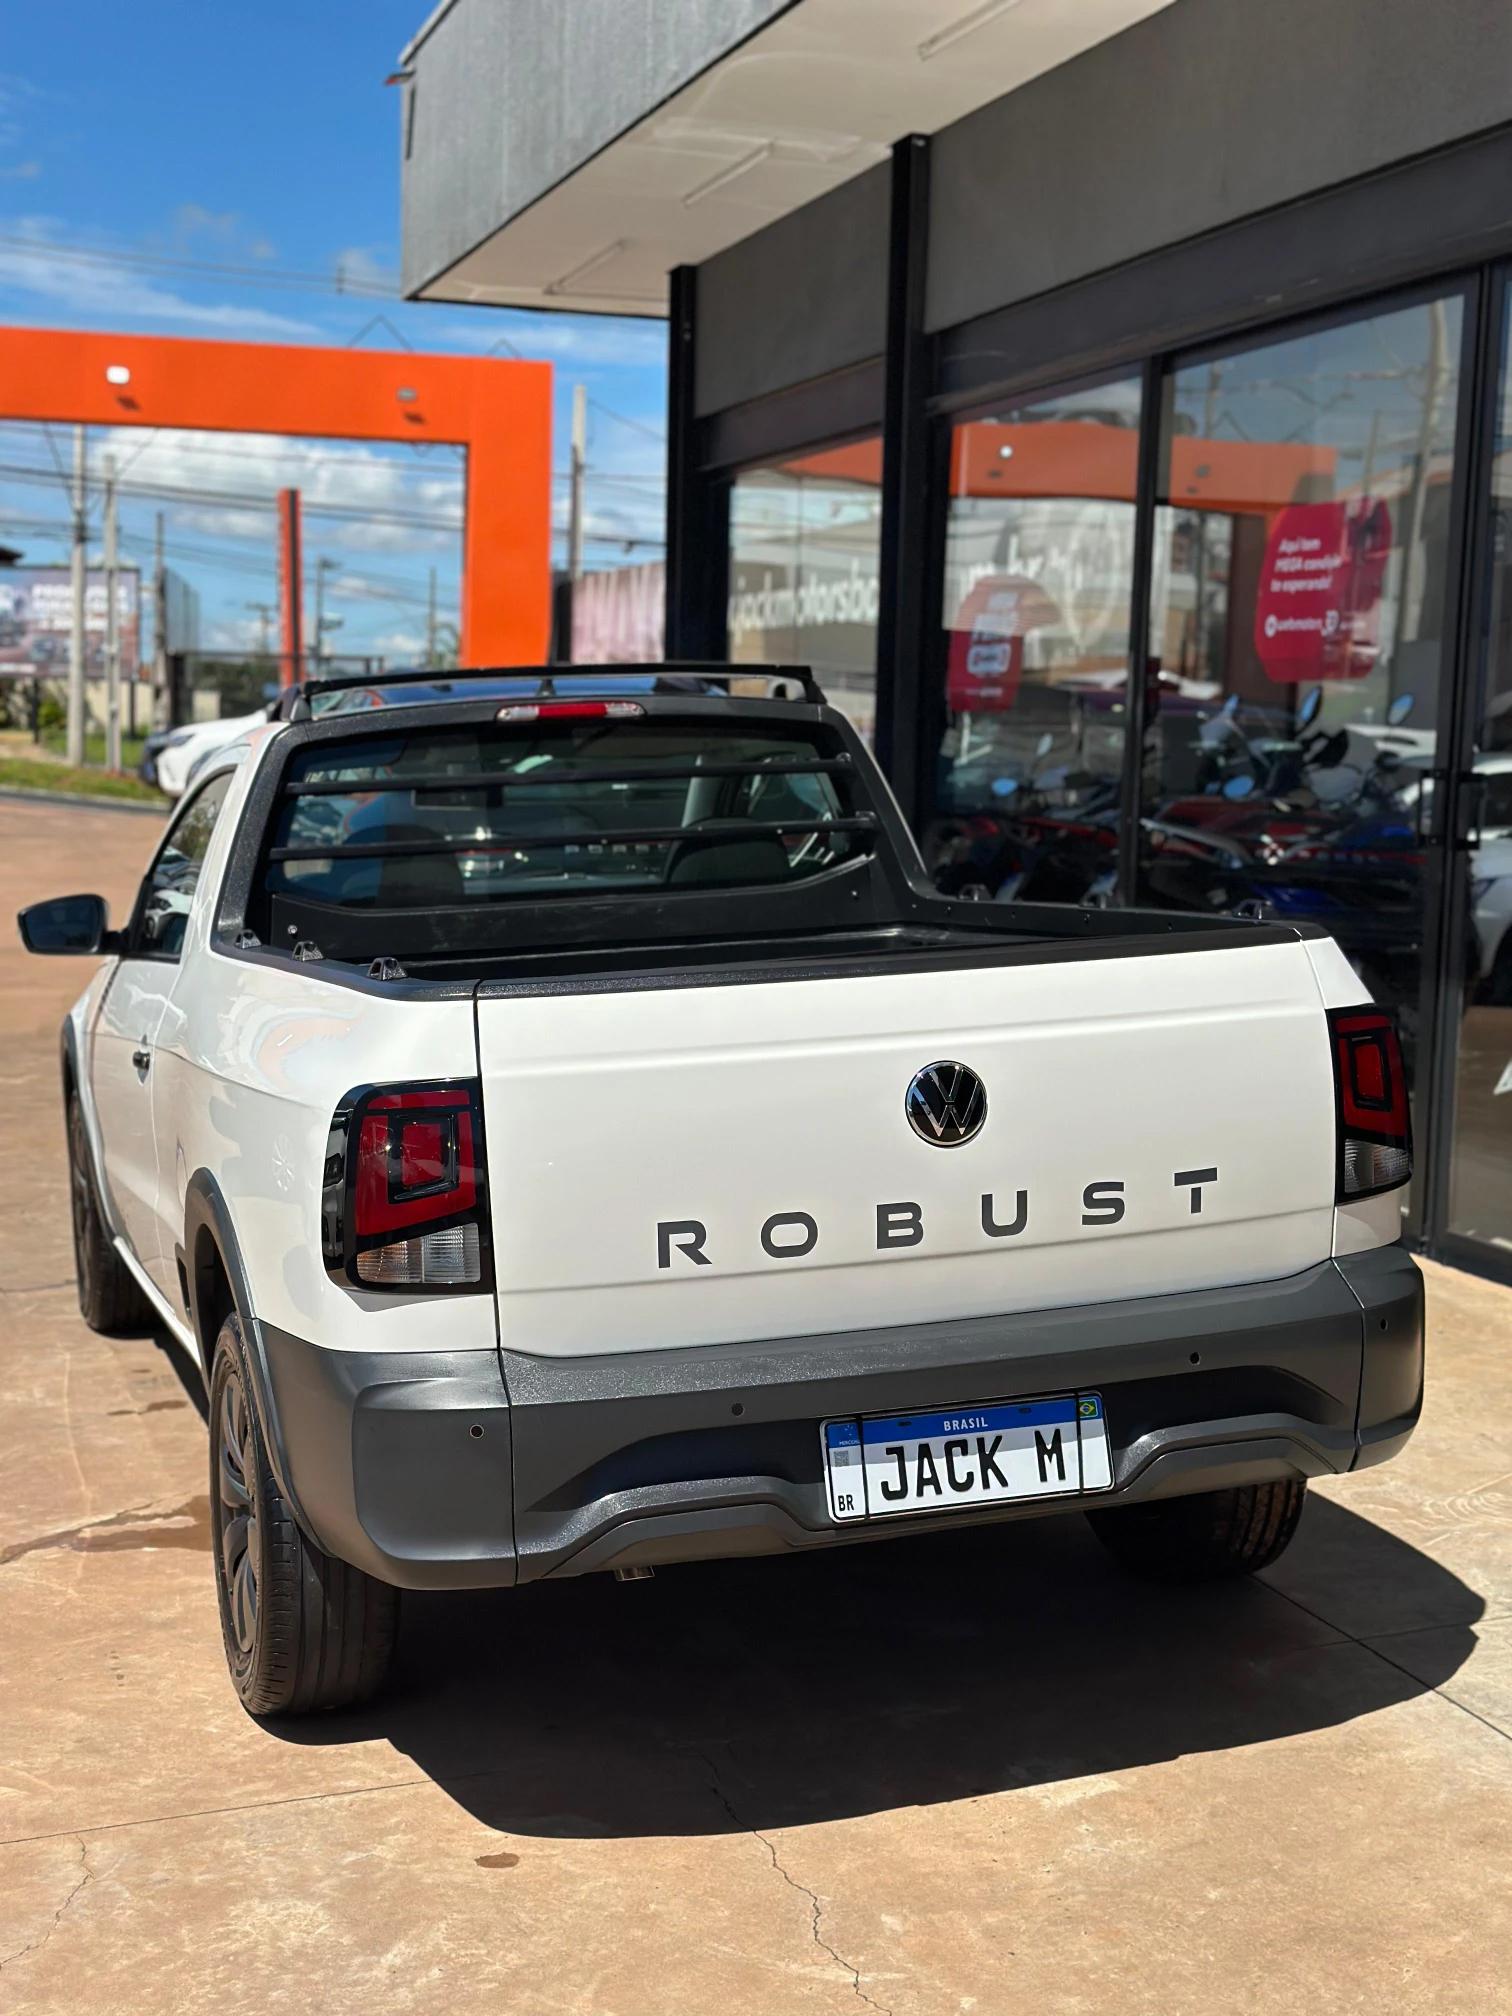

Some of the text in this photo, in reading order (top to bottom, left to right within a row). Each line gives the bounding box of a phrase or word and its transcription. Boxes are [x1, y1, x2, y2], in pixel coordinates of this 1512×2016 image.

[657, 1167, 1218, 1269] ROBUST
[943, 1416, 988, 1432] BRASIL
[881, 1428, 1066, 1501] JACK M
[838, 1494, 854, 1511] BR
